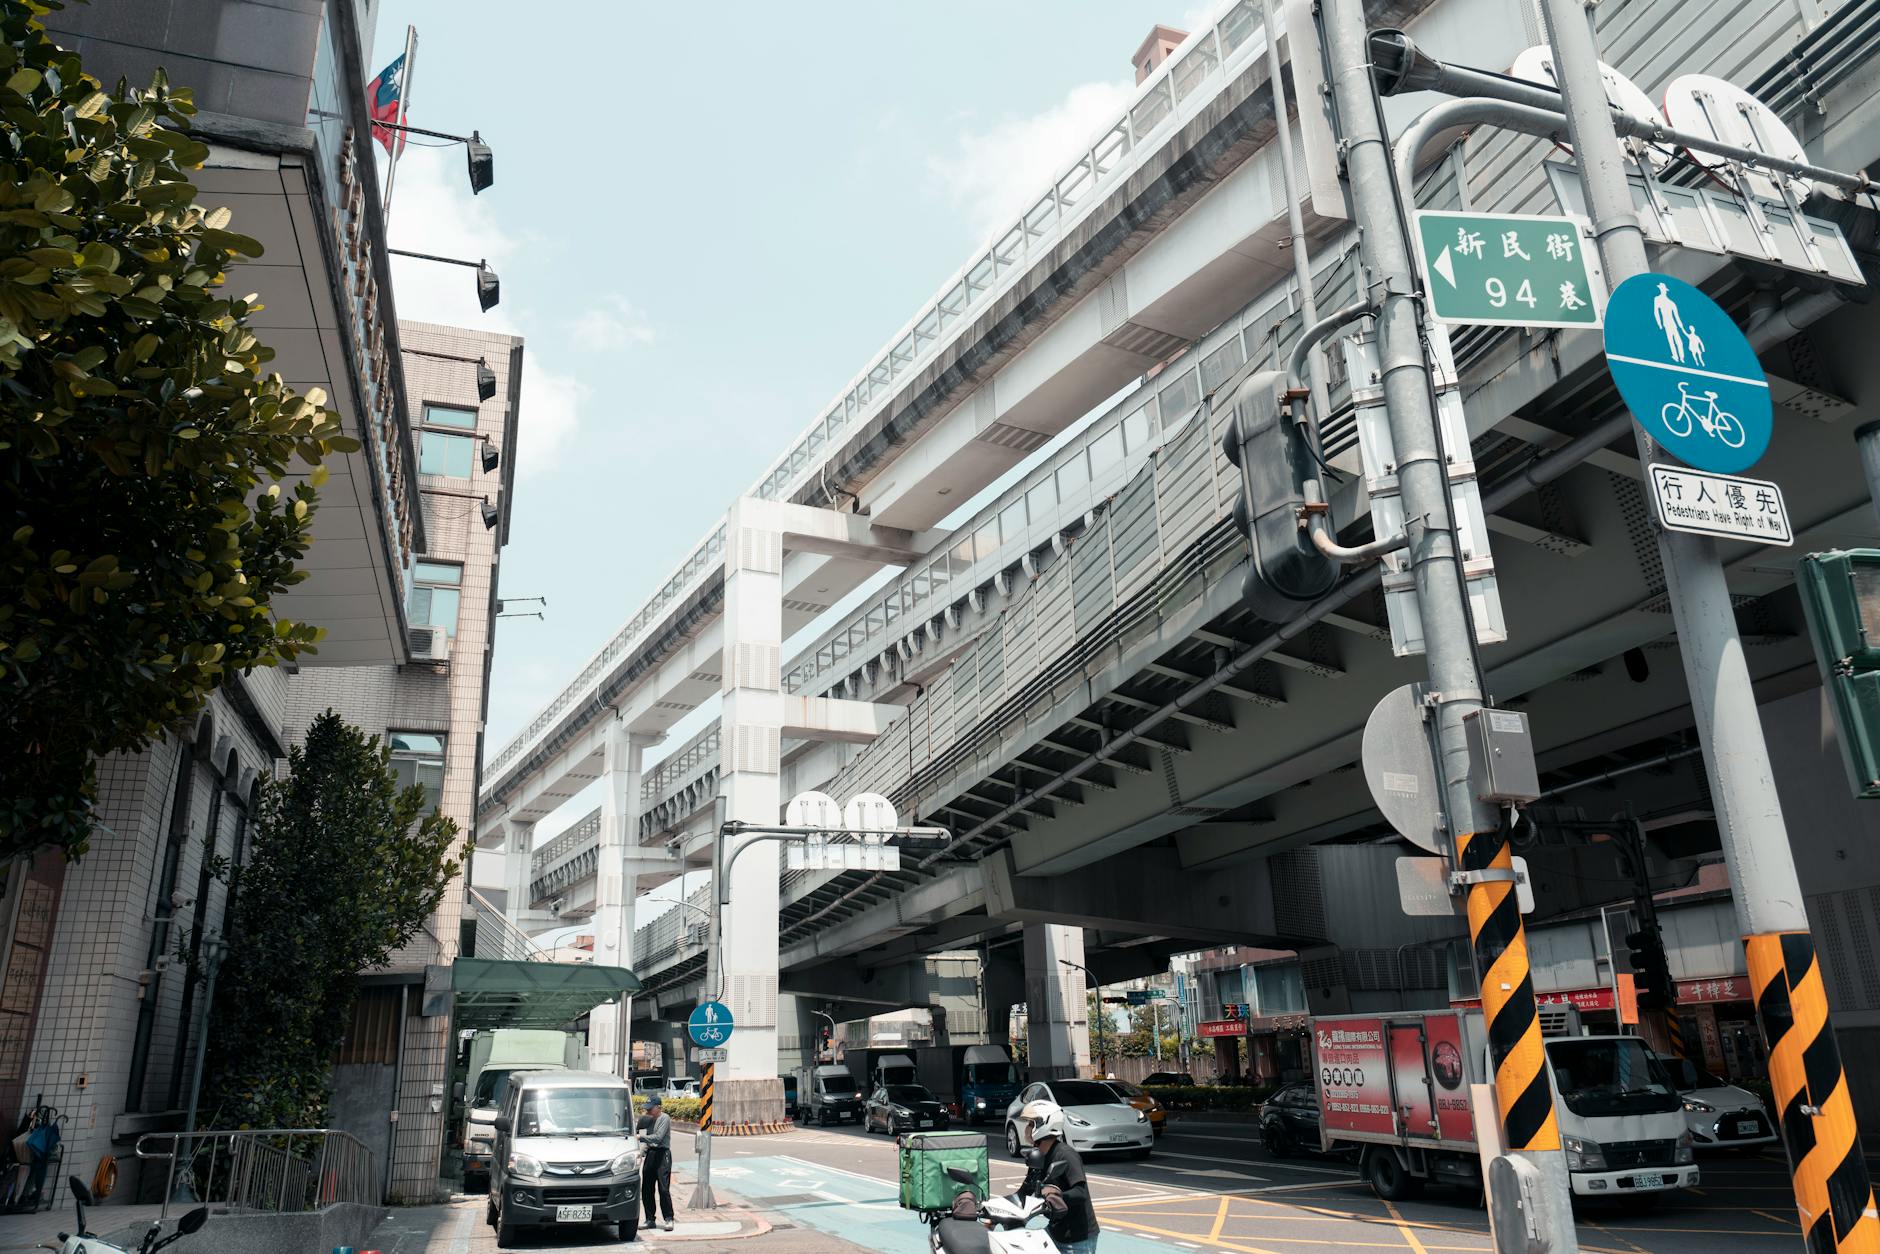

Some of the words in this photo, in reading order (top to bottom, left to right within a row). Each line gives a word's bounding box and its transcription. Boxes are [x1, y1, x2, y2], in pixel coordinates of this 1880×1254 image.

[1454, 227, 1575, 262] 新民街
[1661, 475, 1778, 515] 行人優先
[1666, 502, 1710, 521] Pedestrians
[1713, 509, 1731, 524] Have
[1734, 512, 1754, 531] Right
[1757, 518, 1765, 528] of
[1767, 517, 1782, 534] Way
[1691, 979, 1738, 1000] 牛樟芝
[1224, 1004, 1250, 1019] 天珠
